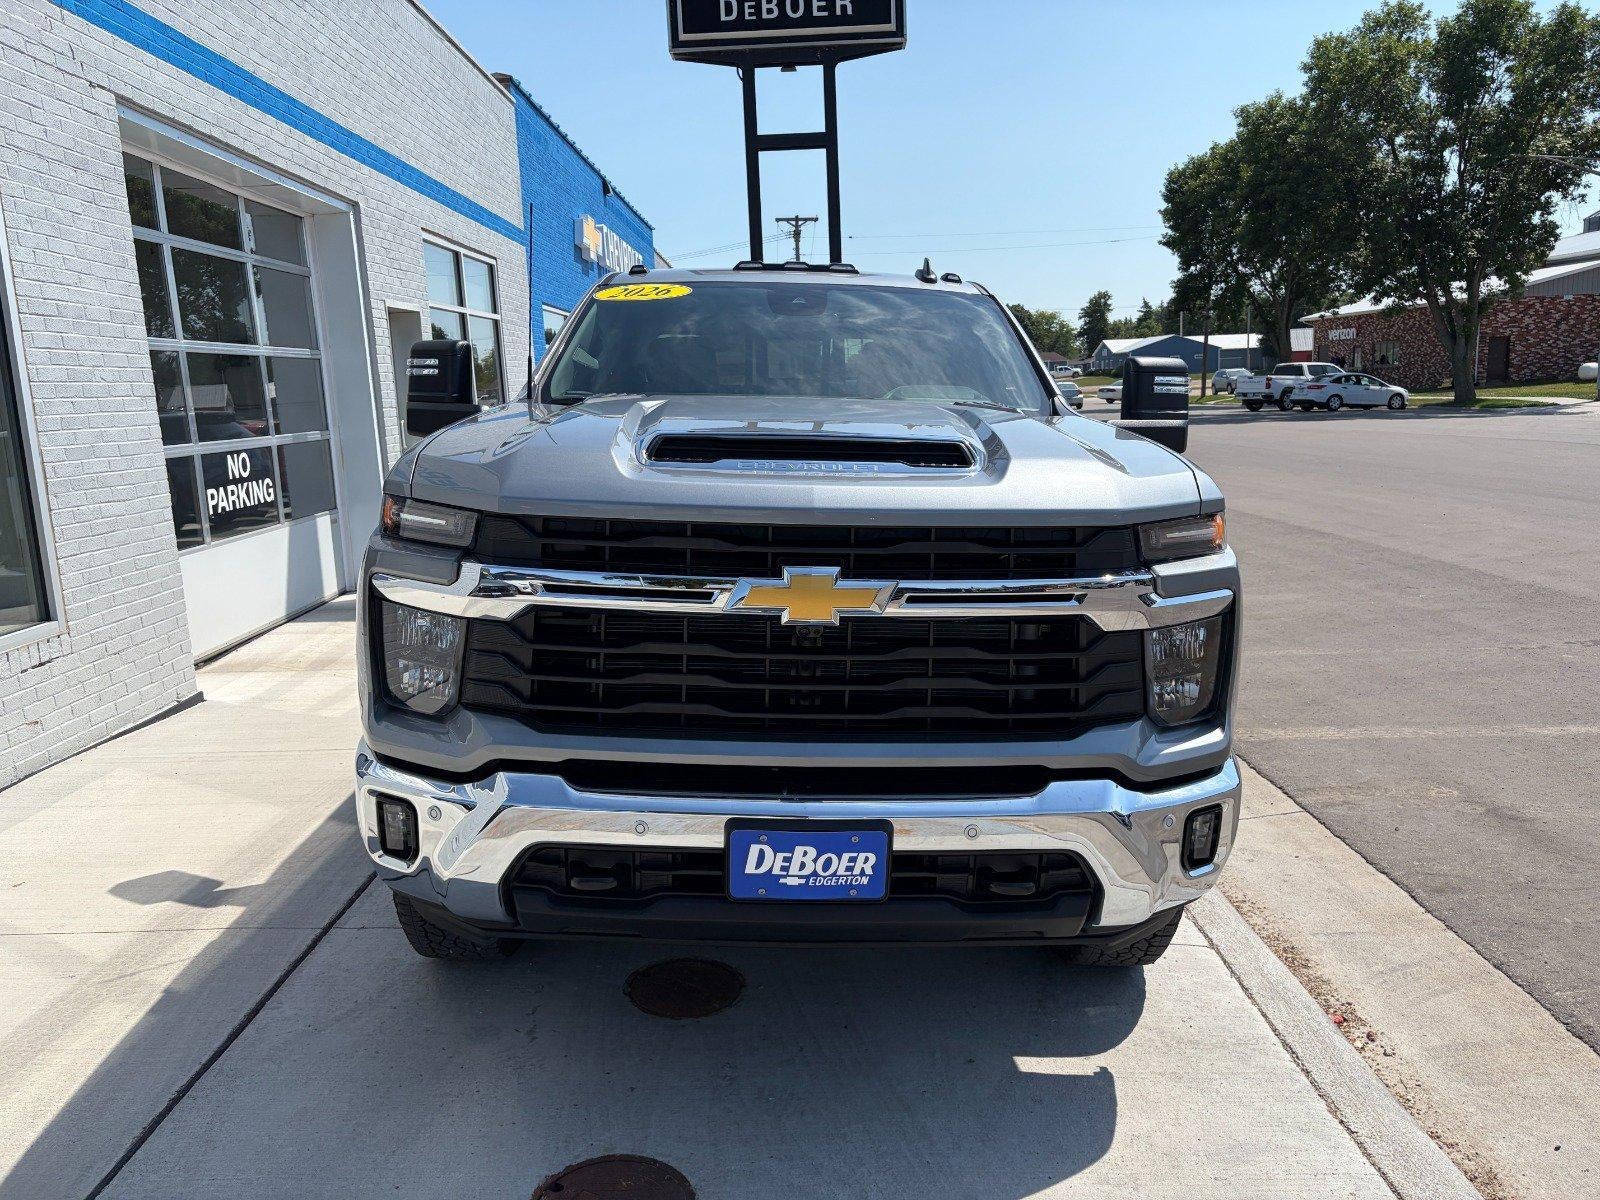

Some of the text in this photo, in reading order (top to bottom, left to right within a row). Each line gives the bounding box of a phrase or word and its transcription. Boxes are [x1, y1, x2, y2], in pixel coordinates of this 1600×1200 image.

[607, 286, 674, 298] 2026
[1328, 327, 1357, 340] verizon
[226, 452, 251, 479] NO
[206, 477, 275, 515] PARKING
[808, 876, 870, 886] EDGERTON
